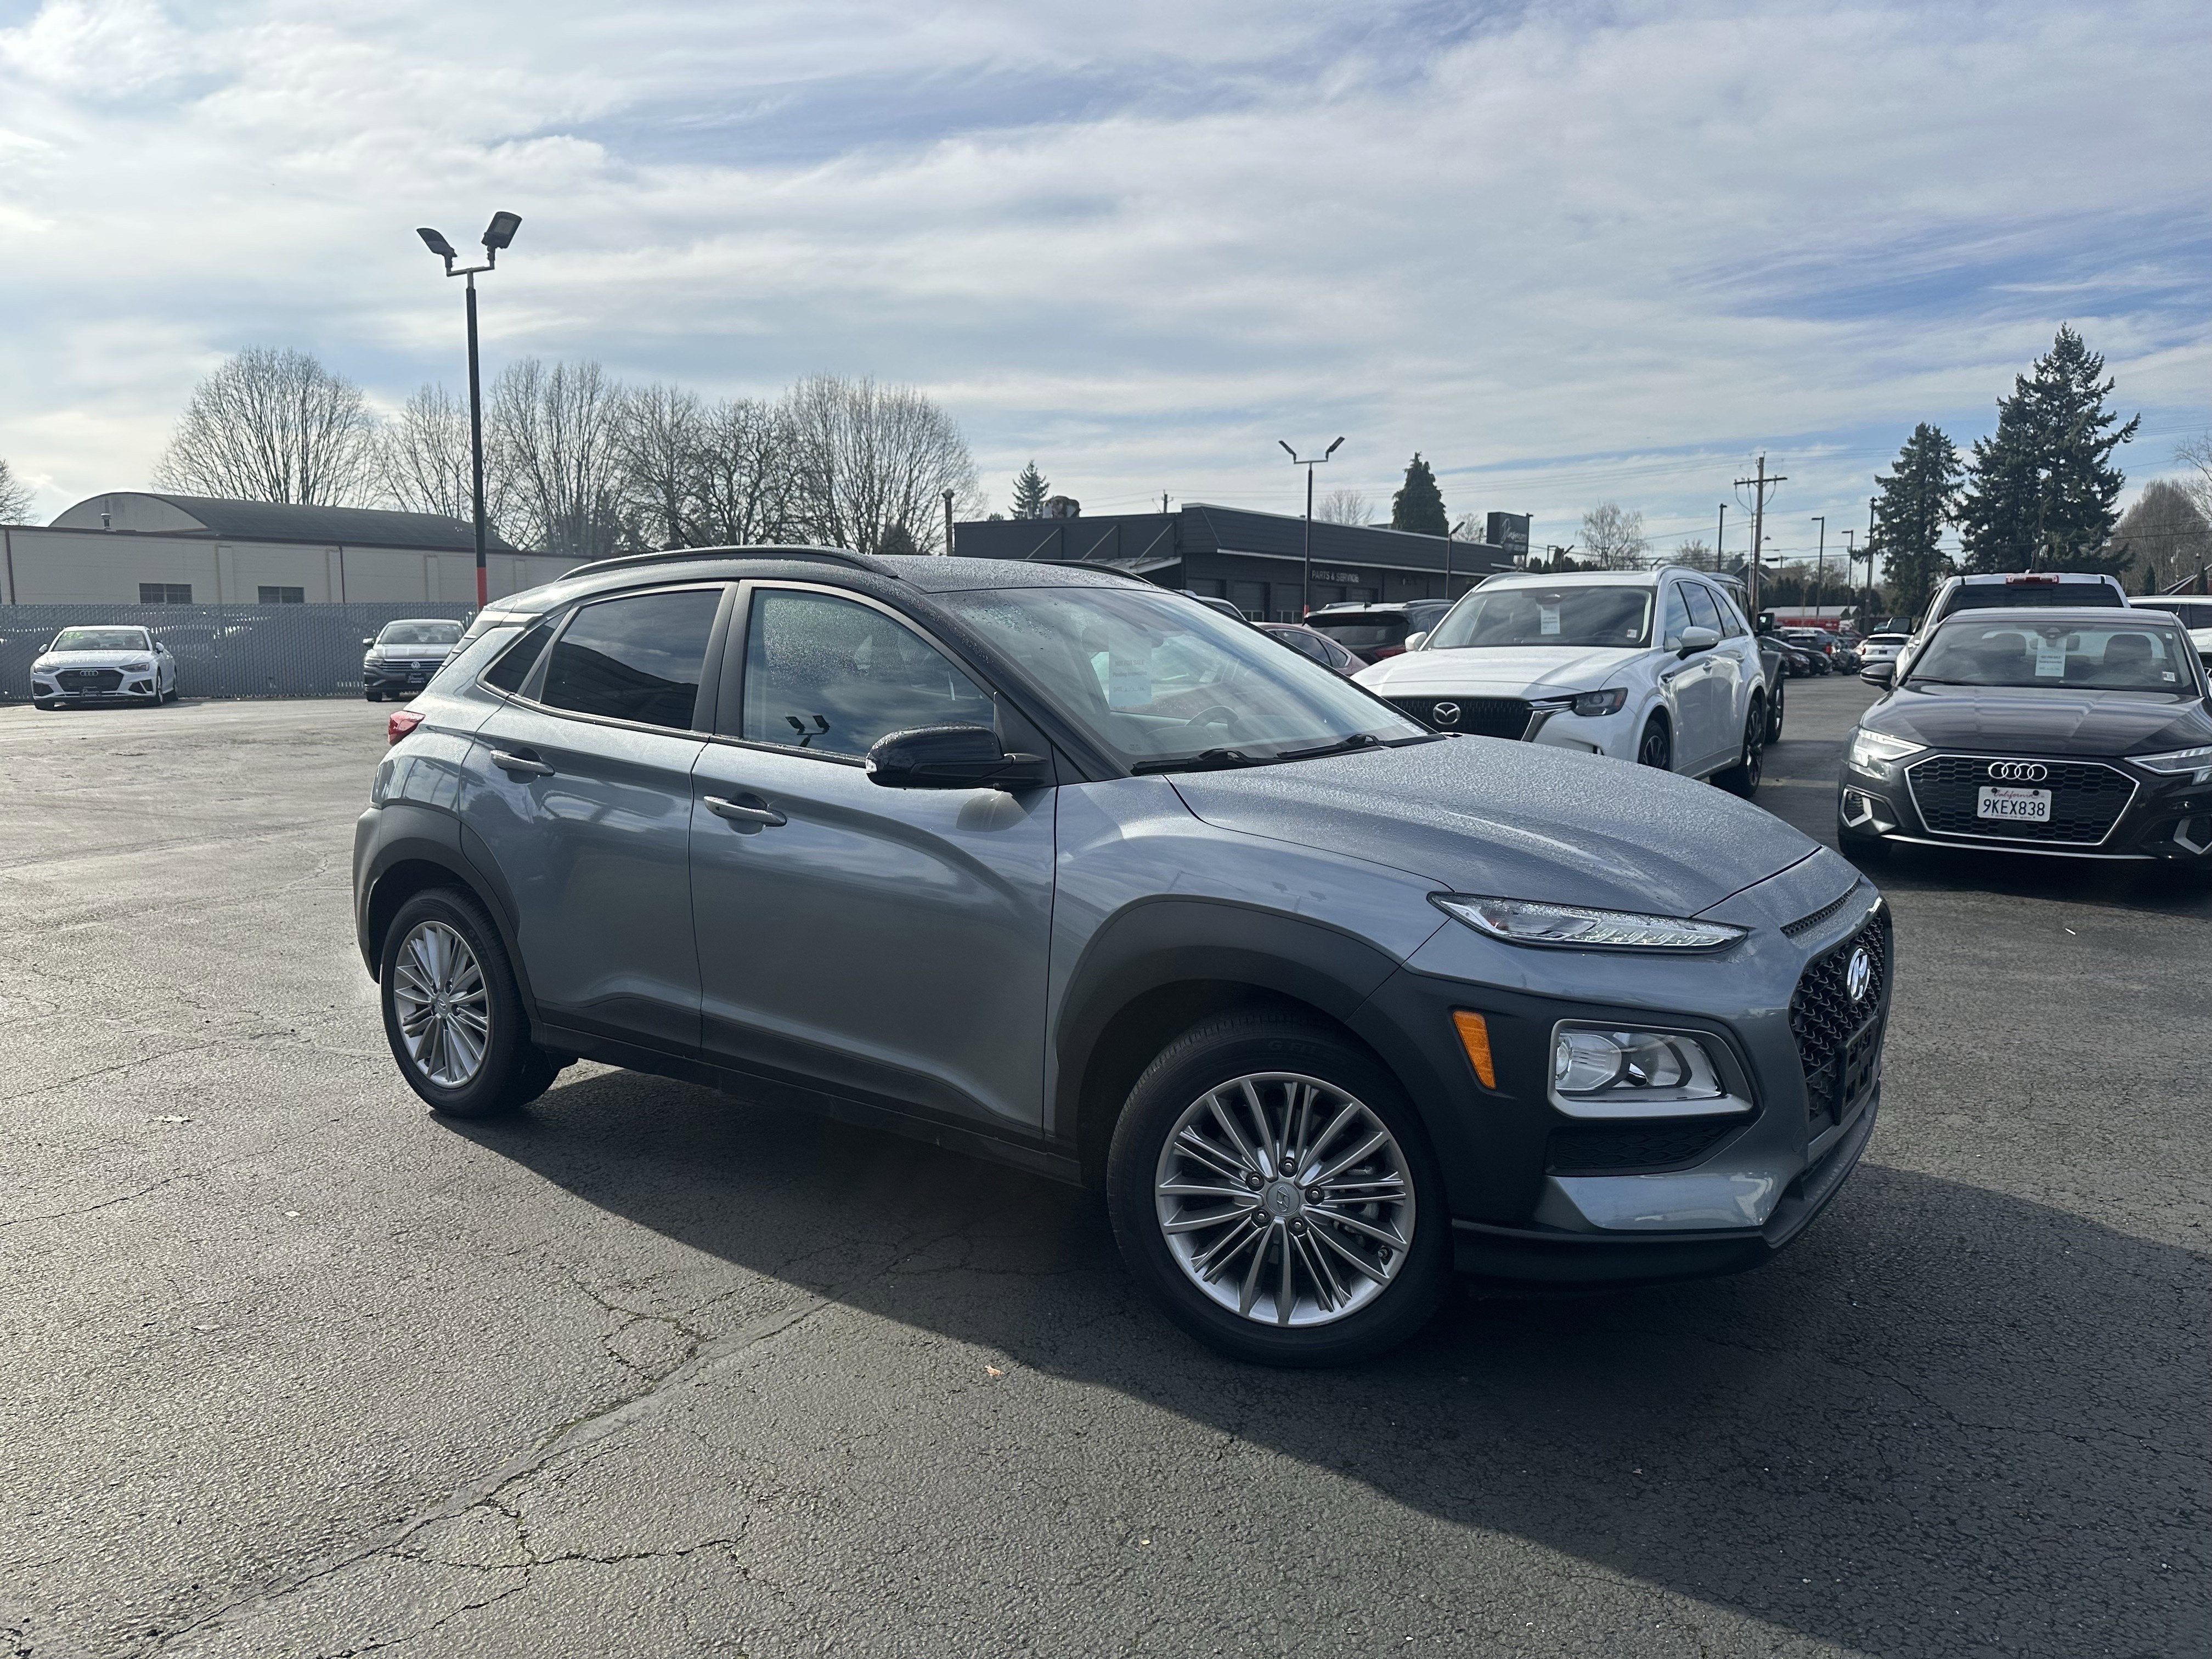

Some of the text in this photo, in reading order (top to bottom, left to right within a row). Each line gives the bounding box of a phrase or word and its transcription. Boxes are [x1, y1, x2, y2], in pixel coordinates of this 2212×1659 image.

[1312, 570, 1330, 580] PARTS
[1336, 573, 1360, 583] SERVICE
[1983, 799, 2045, 816] 9KEX838
